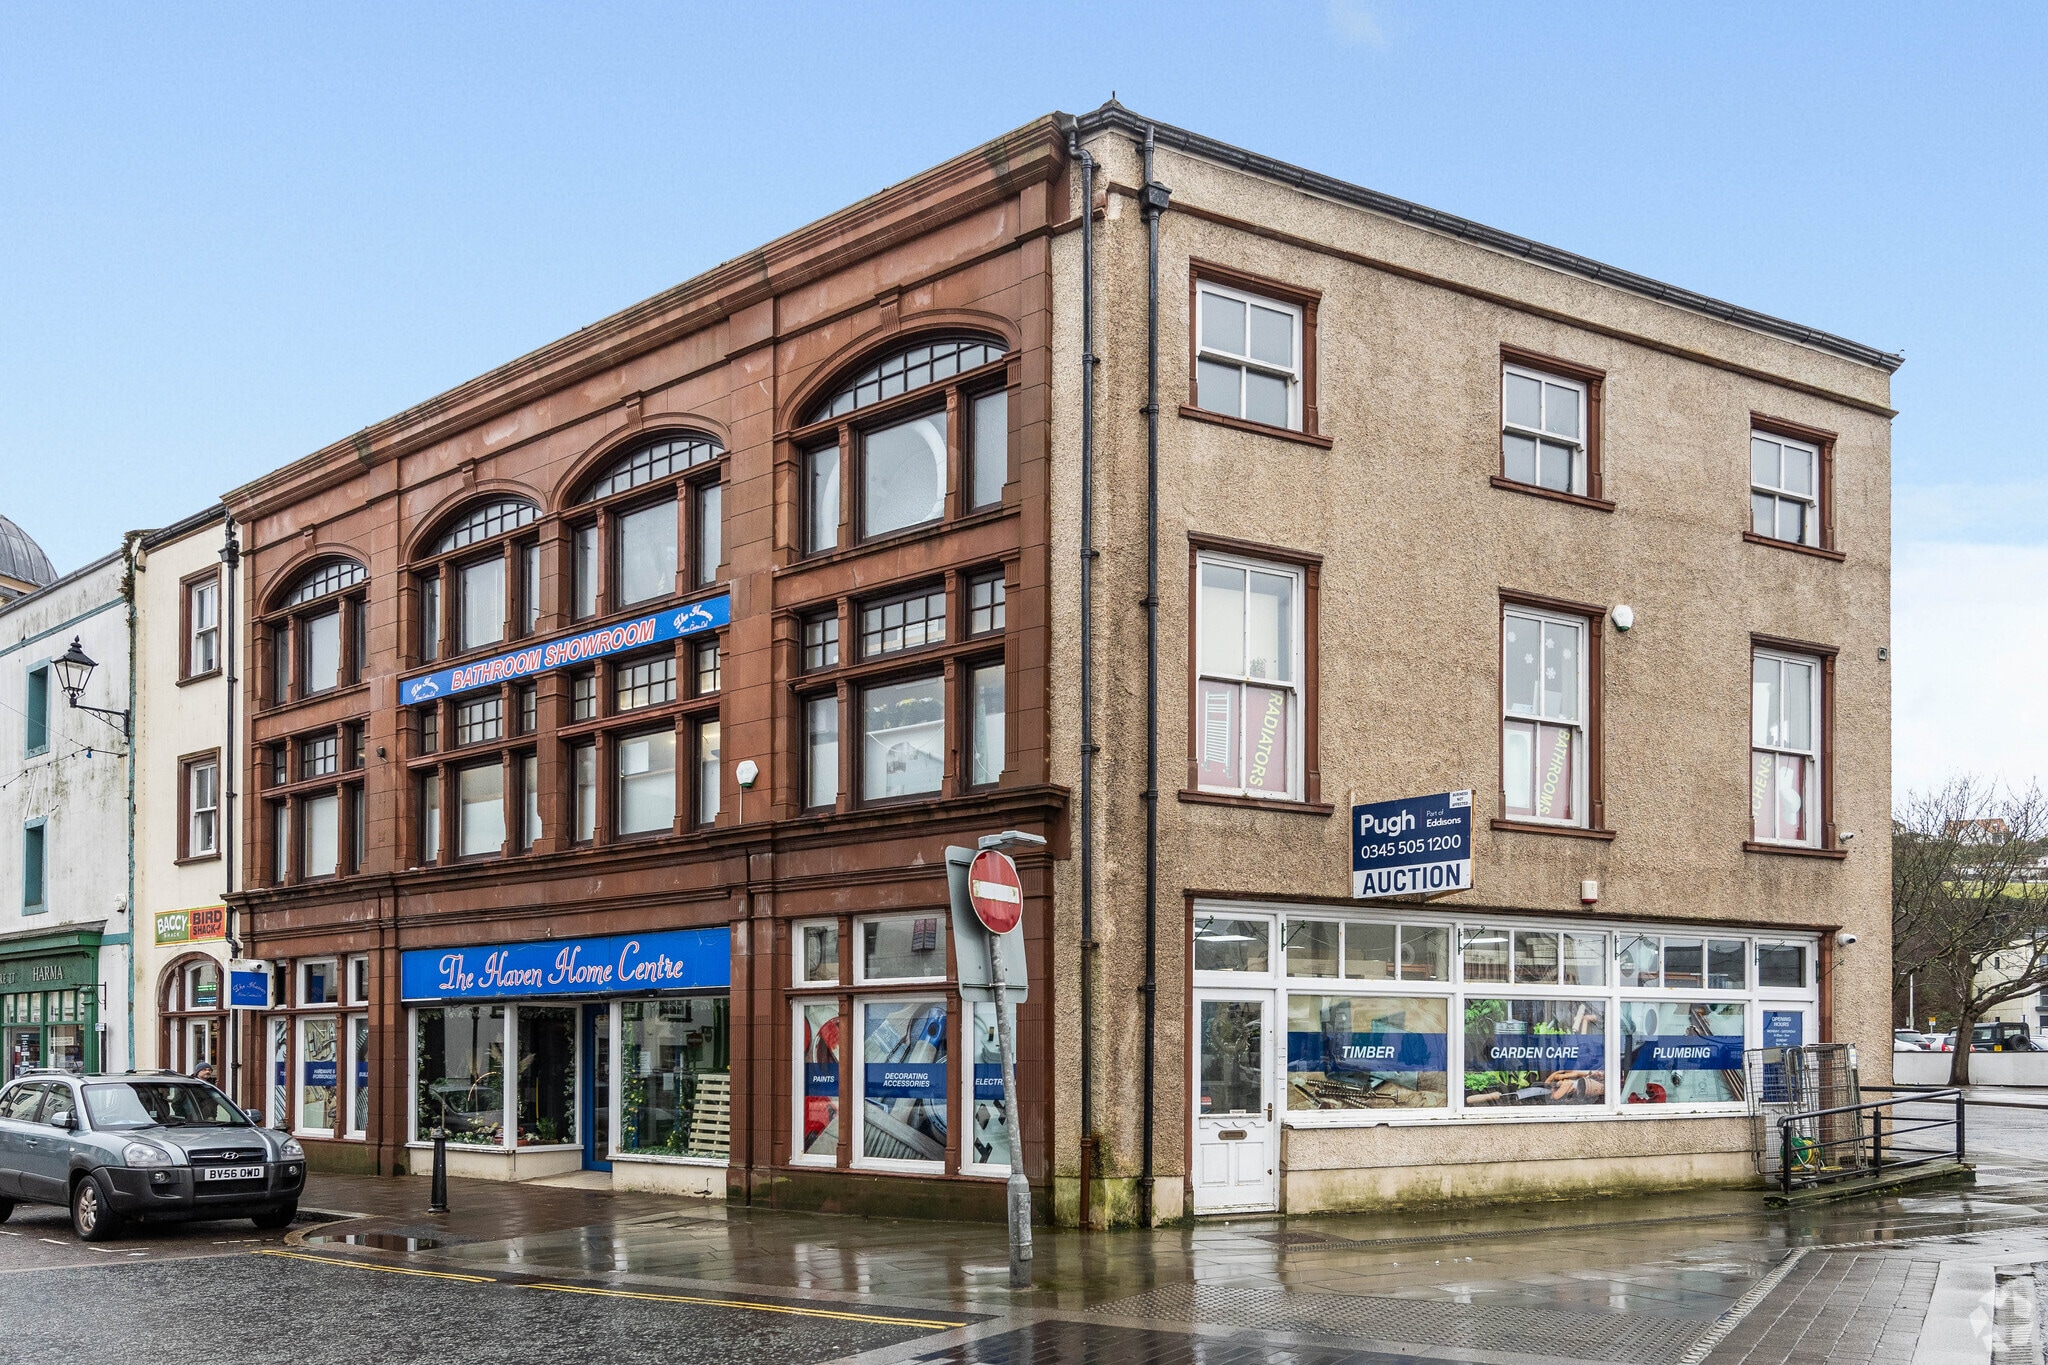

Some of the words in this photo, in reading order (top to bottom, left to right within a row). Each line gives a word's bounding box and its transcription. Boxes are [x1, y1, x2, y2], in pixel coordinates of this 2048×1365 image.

[674, 613, 688, 630] The
[450, 649, 542, 691] BATHROOM
[544, 618, 656, 667] SHOWROOM
[1250, 692, 1284, 786] RADIATORS
[1540, 729, 1570, 814] BATHROOMS
[1361, 810, 1416, 837] Pugh
[1426, 818, 1462, 828] Eddisons
[1362, 842, 1396, 859] 0345
[1398, 839, 1425, 855] 505
[1427, 834, 1462, 852] 1200
[1362, 864, 1460, 894] AUCTION
[158, 914, 188, 934] BACCY
[192, 910, 222, 925] BIRD
[193, 923, 216, 935] SHACK
[438, 954, 474, 990] The
[478, 950, 542, 988] Haven
[548, 946, 612, 985] Home
[618, 940, 683, 982] Centre
[1342, 1046, 1395, 1058] TIMBER
[1491, 1047, 1543, 1058] GARDEN
[1546, 1047, 1579, 1058] CARE
[1653, 1047, 1710, 1058] PLUMBING
[210, 1169, 237, 1178] BV56
[240, 1168, 260, 1177] OWD
